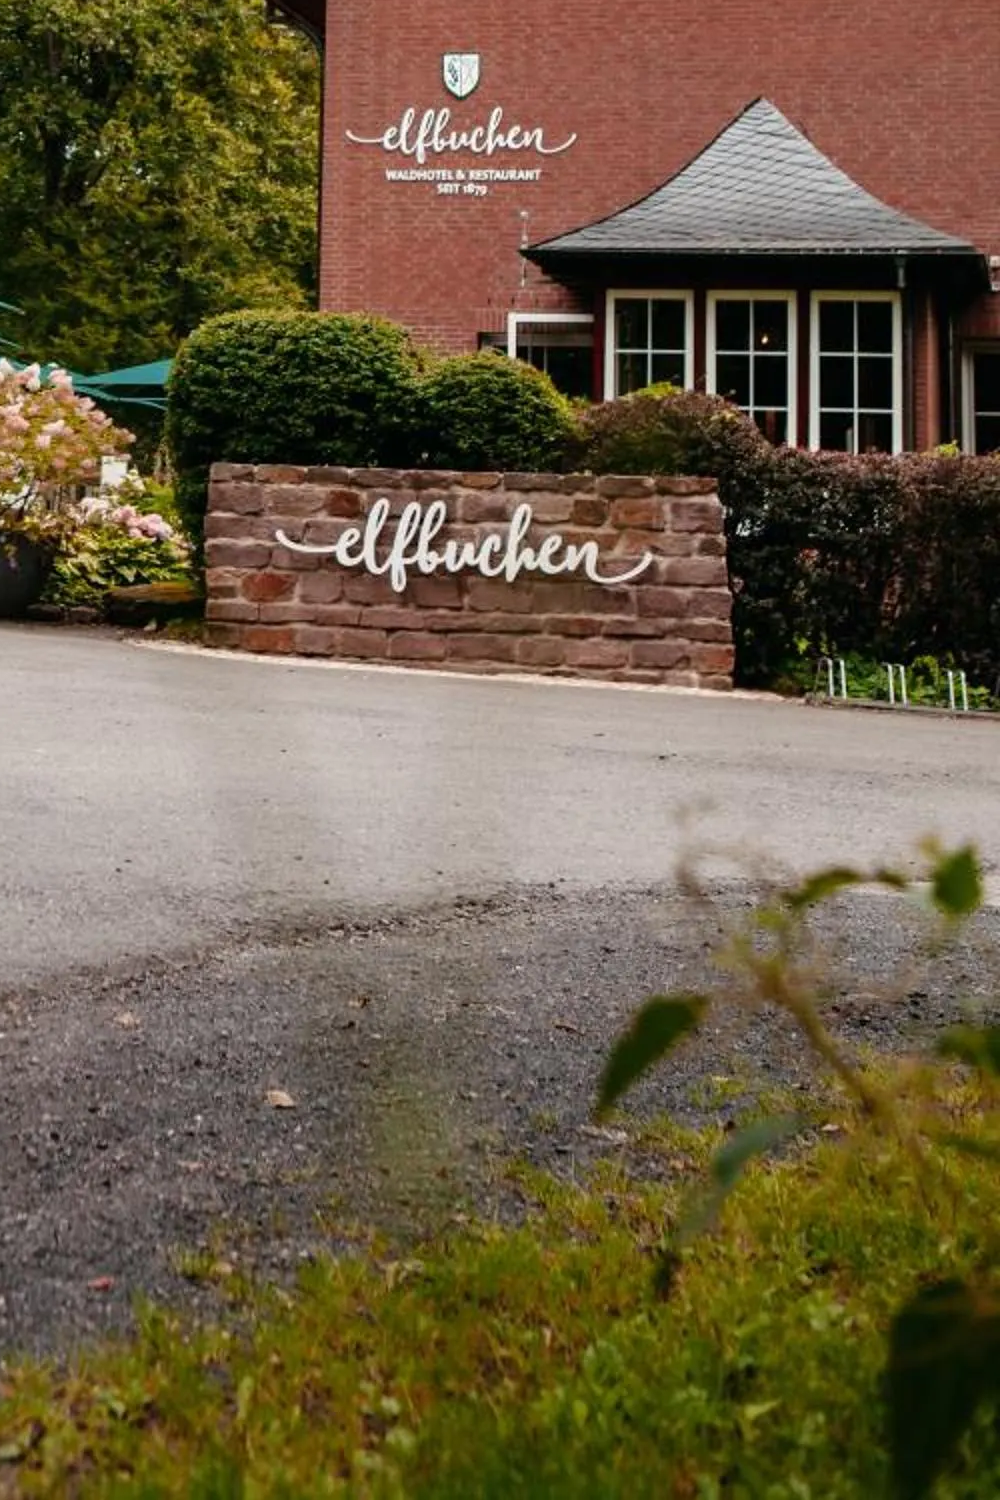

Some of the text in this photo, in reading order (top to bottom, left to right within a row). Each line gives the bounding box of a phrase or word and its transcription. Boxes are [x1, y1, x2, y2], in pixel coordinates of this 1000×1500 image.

[346, 106, 577, 164] elfbuchen
[385, 169, 542, 181] WALDHOTEL & RESTAURANT
[437, 183, 459, 195] SEIT
[275, 498, 653, 592] elfbuchen
